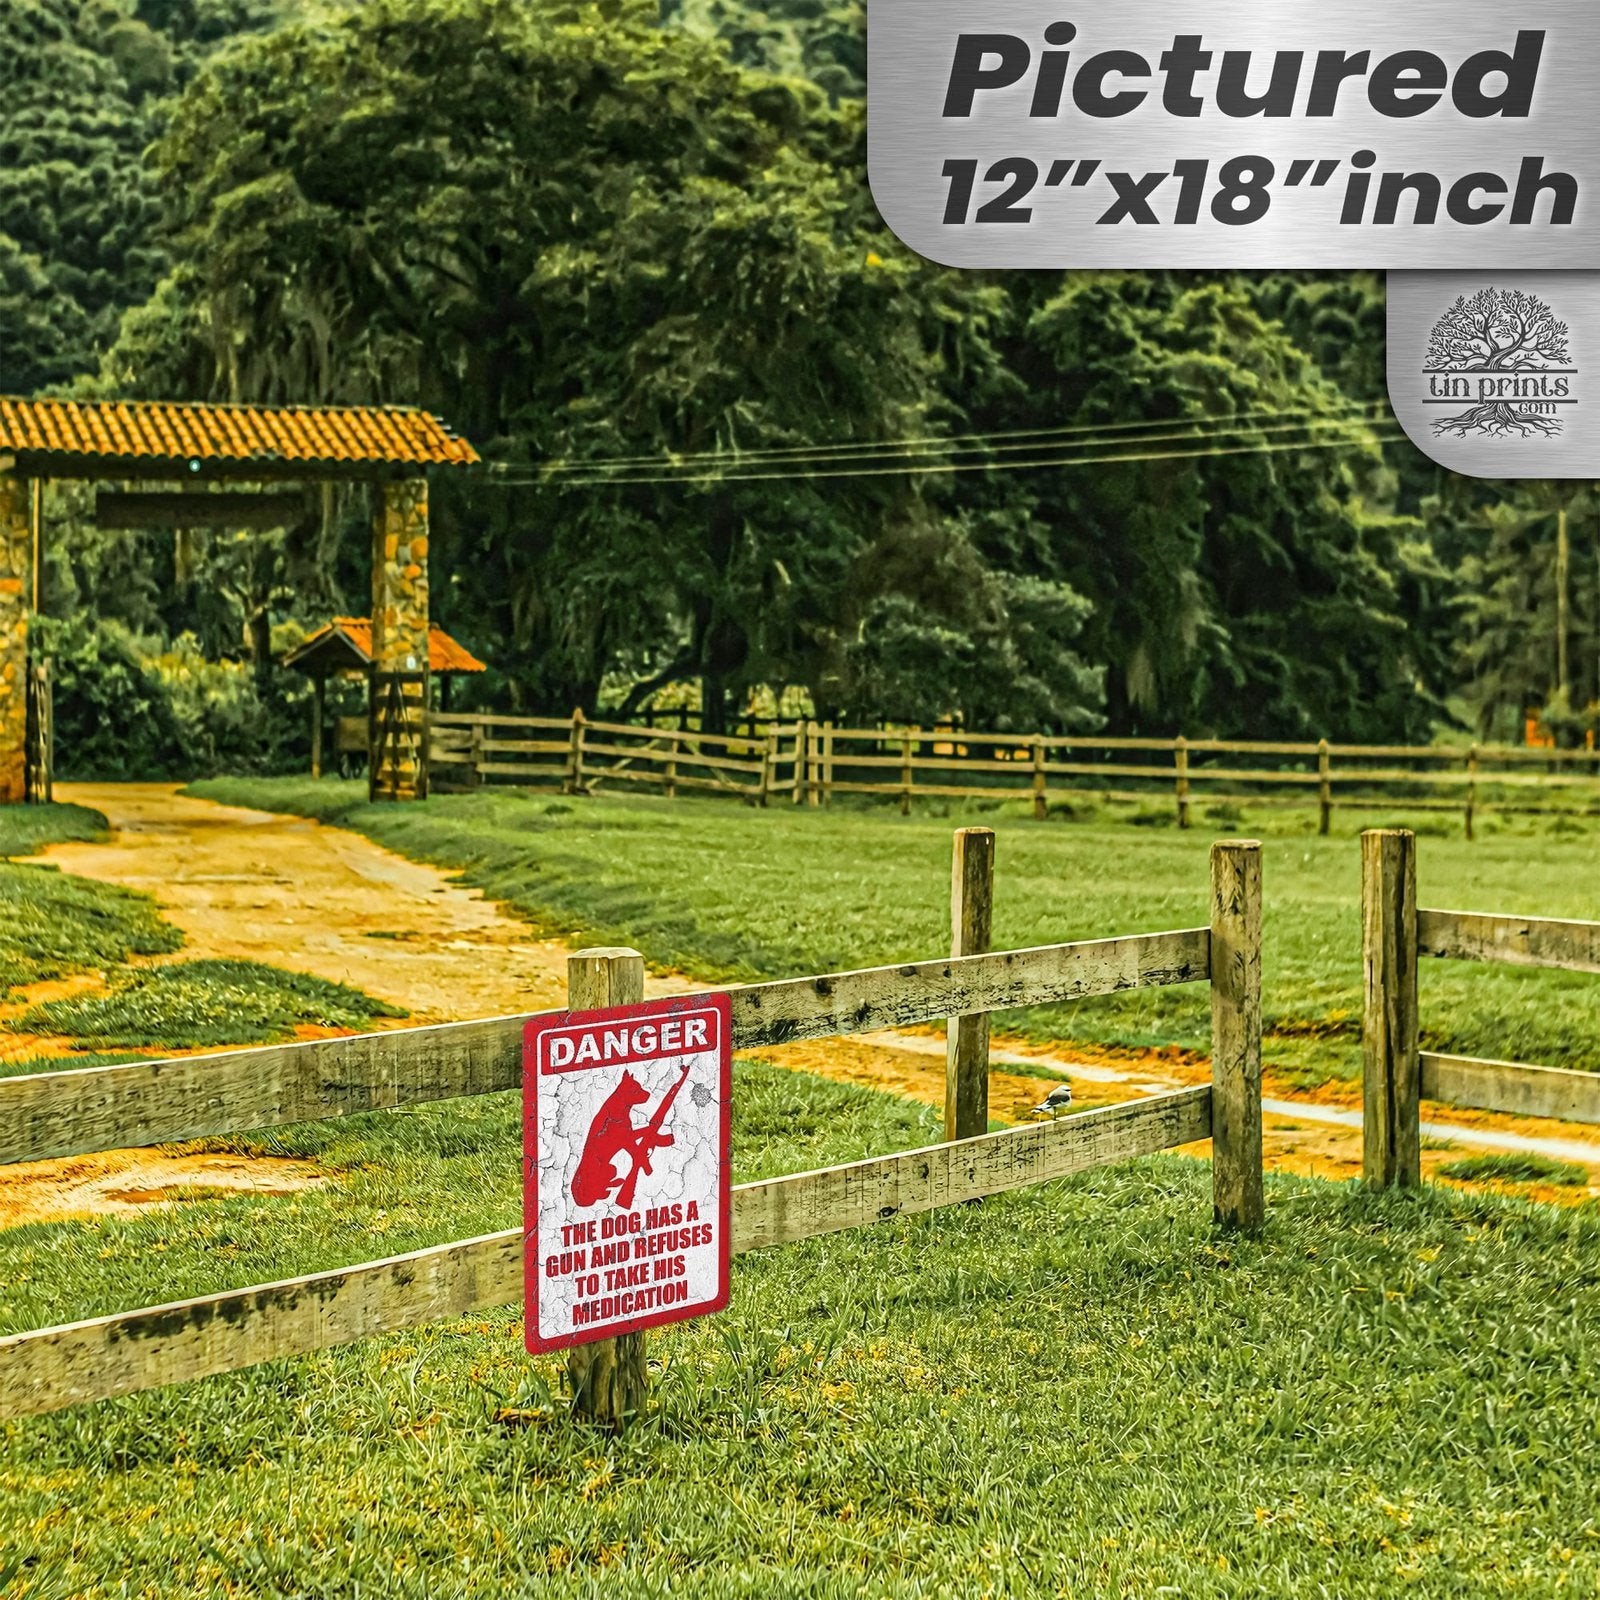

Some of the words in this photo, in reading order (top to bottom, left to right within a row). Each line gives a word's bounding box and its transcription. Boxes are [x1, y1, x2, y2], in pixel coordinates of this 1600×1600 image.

[549, 1017, 708, 1068] DANGER
[560, 1221, 597, 1248] THE
[601, 1211, 640, 1240] DOG
[646, 1203, 683, 1230] HAS
[687, 1200, 699, 1222] A
[545, 1246, 586, 1278] GUN
[590, 1237, 630, 1269] AND
[635, 1223, 713, 1260] REFUSES
[575, 1275, 599, 1298] TO
[604, 1262, 649, 1293] TAKE
[653, 1254, 686, 1281] HIS
[572, 1280, 688, 1327] MEDICATION
